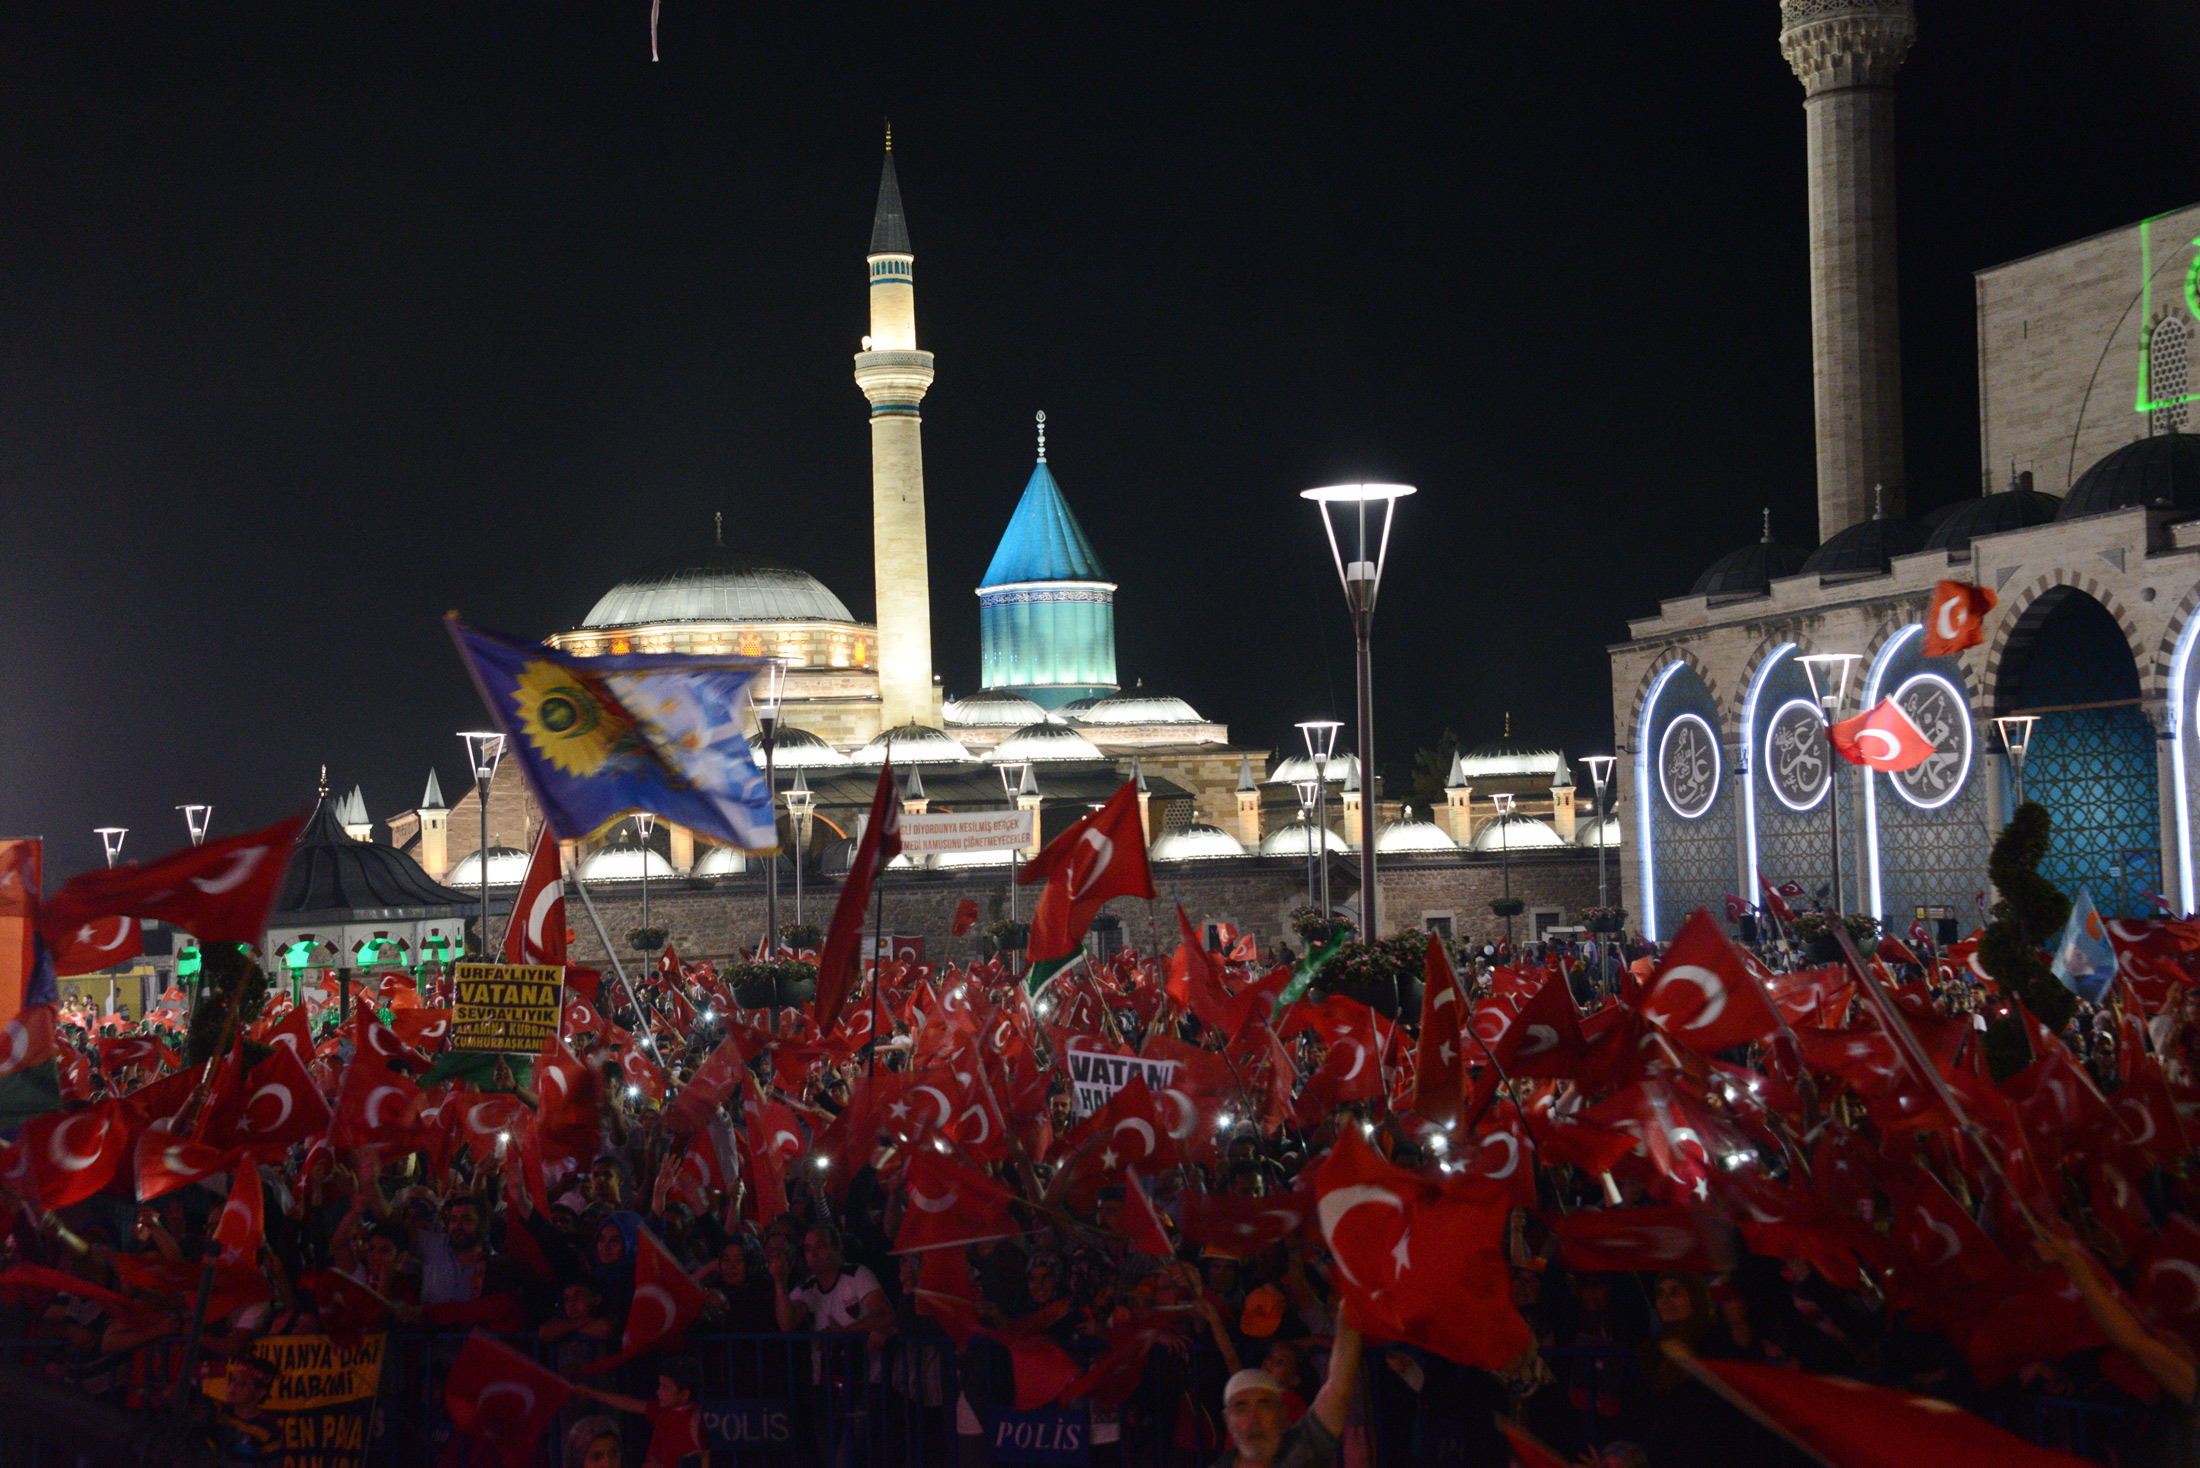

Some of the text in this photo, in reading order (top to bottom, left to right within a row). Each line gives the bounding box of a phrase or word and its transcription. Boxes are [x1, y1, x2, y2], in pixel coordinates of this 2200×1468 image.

[923, 838, 962, 850] NAMUSUNU
[460, 967, 556, 981] URFA'LIYIK
[460, 983, 555, 1006] VATANA
[457, 1007, 554, 1021] SEVDA'LIYIK
[454, 1035, 544, 1050] CUMHURBAŞKANI
[703, 1407, 790, 1441] POLİS
[996, 1417, 1081, 1450] POLİS
